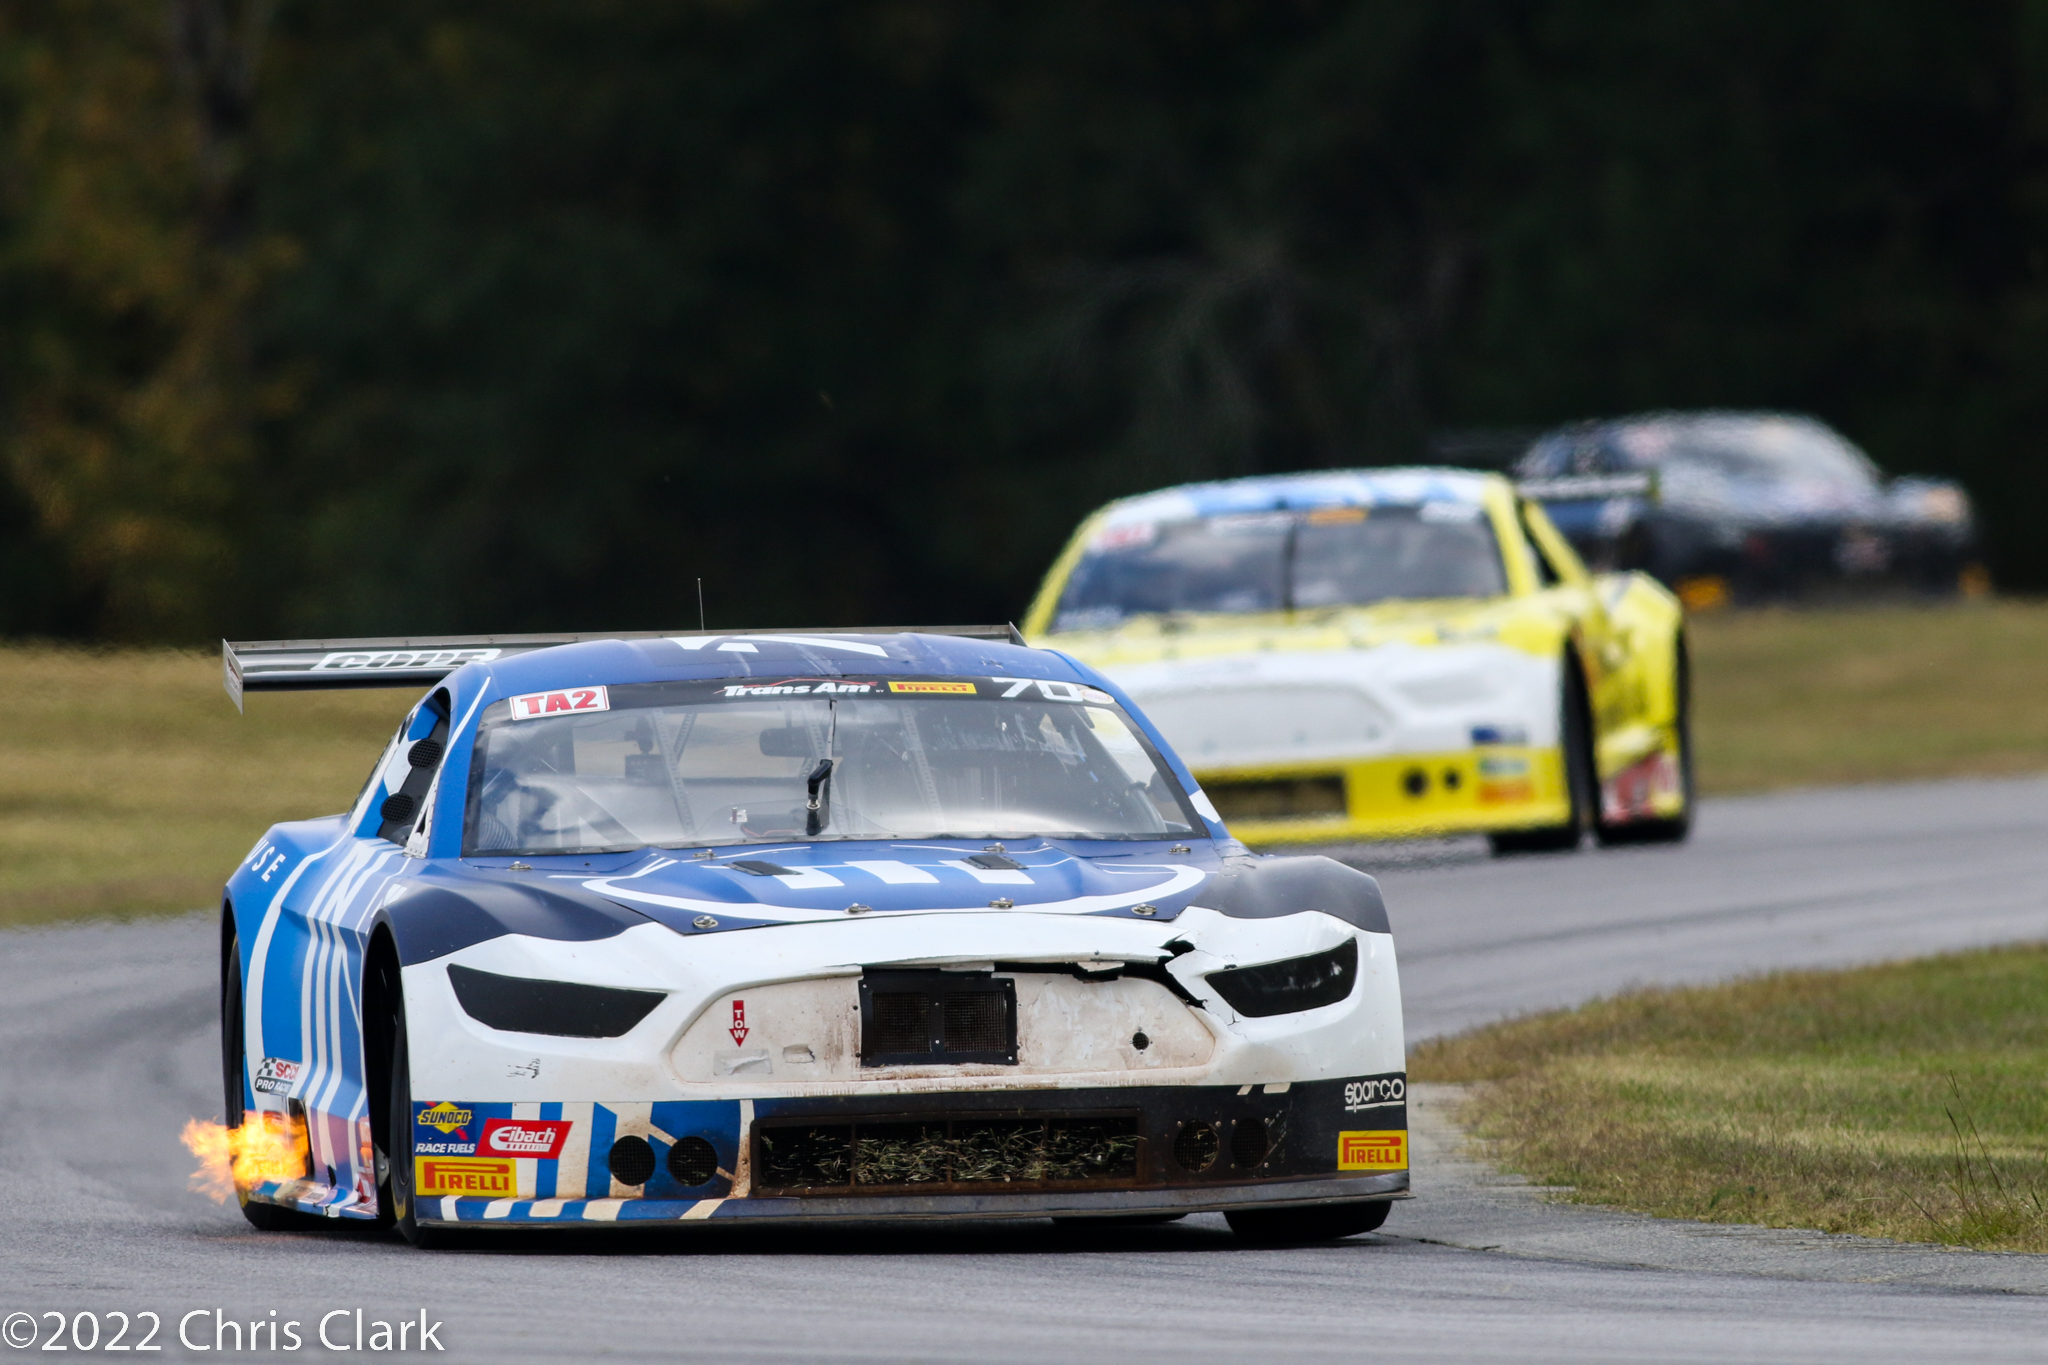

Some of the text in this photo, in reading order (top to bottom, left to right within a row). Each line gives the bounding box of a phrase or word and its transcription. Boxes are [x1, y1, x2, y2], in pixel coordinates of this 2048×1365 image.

[724, 684, 811, 697] Trans
[812, 681, 871, 694] Am
[991, 677, 1084, 702] 70
[520, 690, 598, 715] TA2
[733, 1009, 746, 1039] TOW
[256, 1079, 275, 1090] PRO
[1345, 1079, 1404, 1112] sparco
[419, 1111, 471, 1125] SUNOCO
[415, 1142, 476, 1154] RACE FUELS
[489, 1126, 555, 1152] Eibach
[1342, 1136, 1402, 1164] PIRELLI
[423, 1161, 510, 1191] PIRELLI
